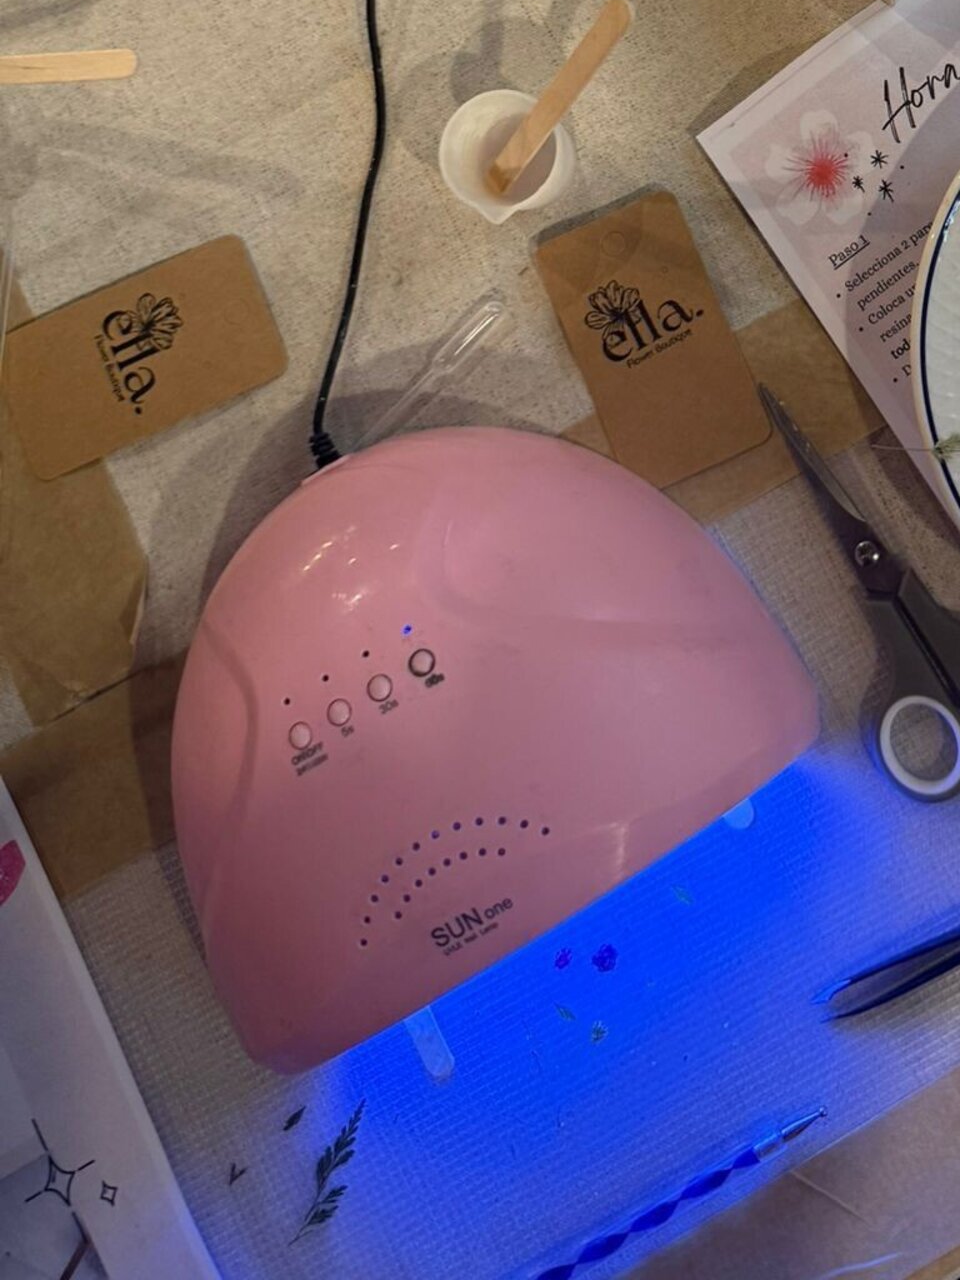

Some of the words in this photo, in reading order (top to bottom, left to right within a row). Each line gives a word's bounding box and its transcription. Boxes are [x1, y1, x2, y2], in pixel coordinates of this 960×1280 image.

[827, 240, 862, 267] Paso
[858, 233, 870, 247] 1
[843, 245, 903, 293] Selecciona
[899, 239, 911, 251] 2
[856, 260, 920, 312] pendientes.
[866, 294, 906, 325] Coloca
[602, 299, 704, 363] ella.
[103, 309, 162, 415] ella.
[429, 906, 484, 948] SUN
[483, 897, 514, 920] one
